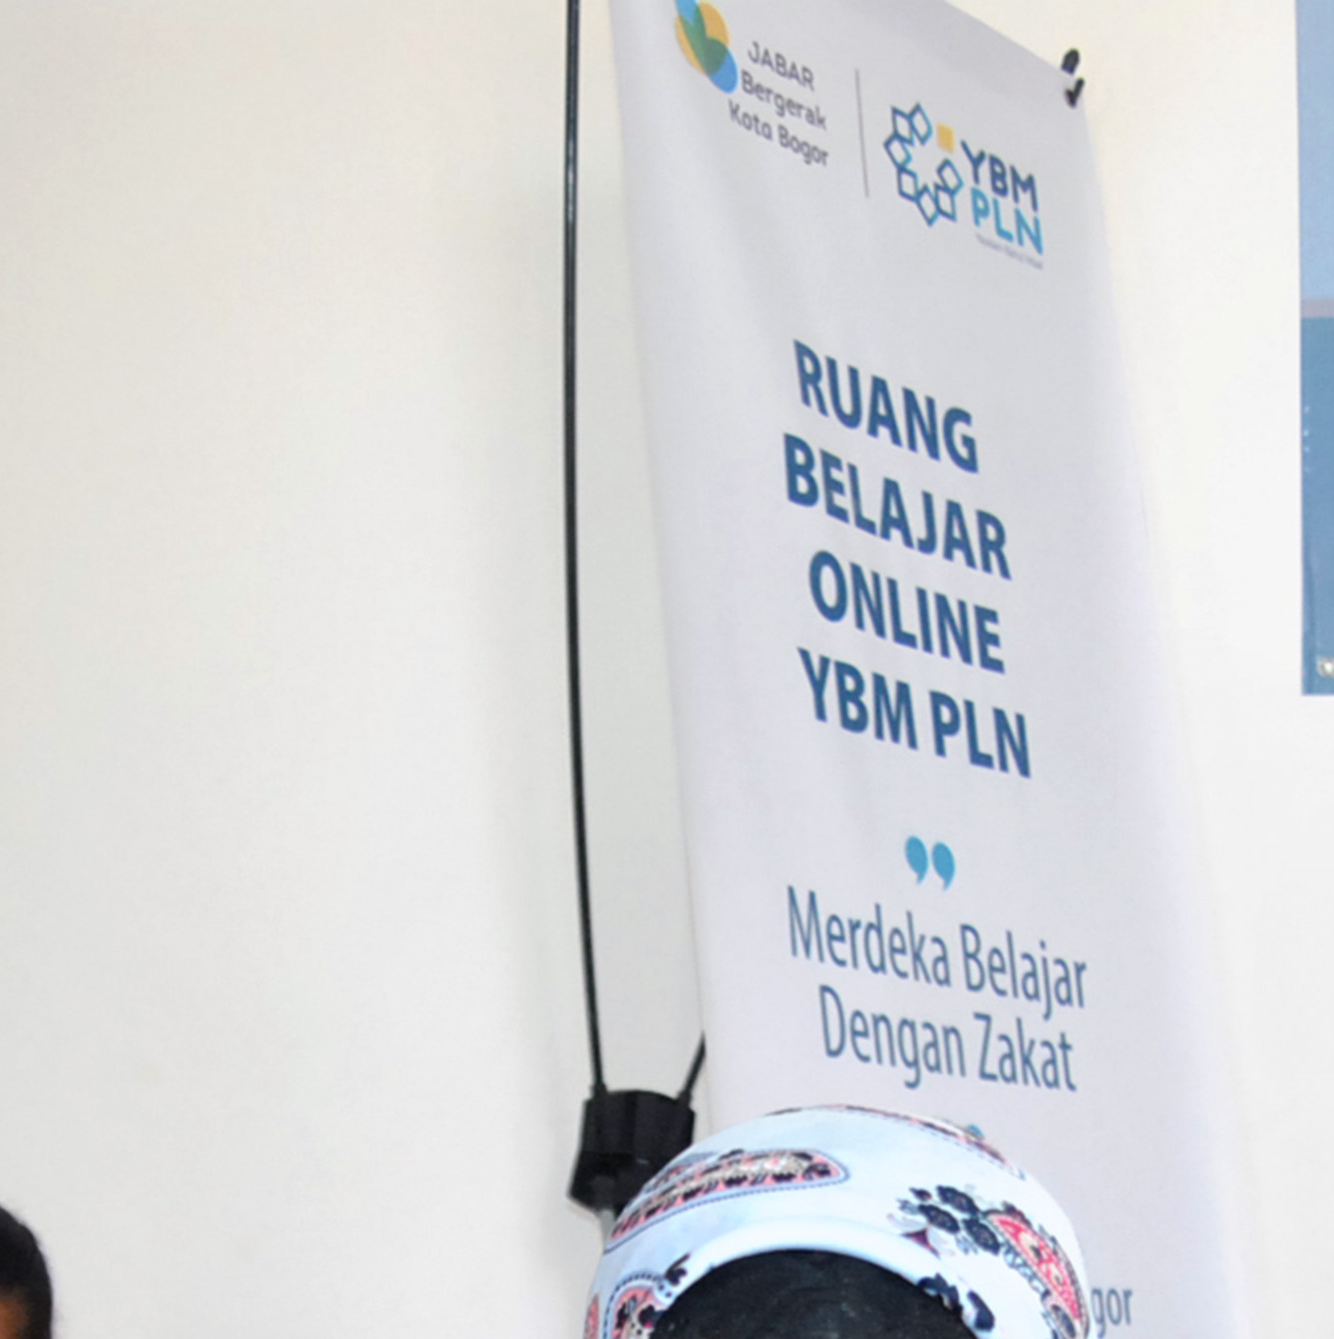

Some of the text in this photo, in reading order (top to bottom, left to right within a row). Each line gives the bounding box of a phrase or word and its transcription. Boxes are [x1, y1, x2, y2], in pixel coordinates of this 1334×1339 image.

[740, 69, 828, 131] Bergerak
[747, 40, 816, 91] JABAR
[728, 99, 831, 168] Kota Bogor
[960, 139, 1040, 213] YBM
[969, 186, 1045, 256] PLN
[792, 338, 980, 475] RUANG
[782, 431, 1013, 581] BELAJAR
[807, 548, 1007, 676] ONLINE
[796, 646, 1033, 780] YBM PLN
[786, 884, 1088, 1023] Merdeka Belajar
[818, 983, 1078, 1093] Dengan Zakat
